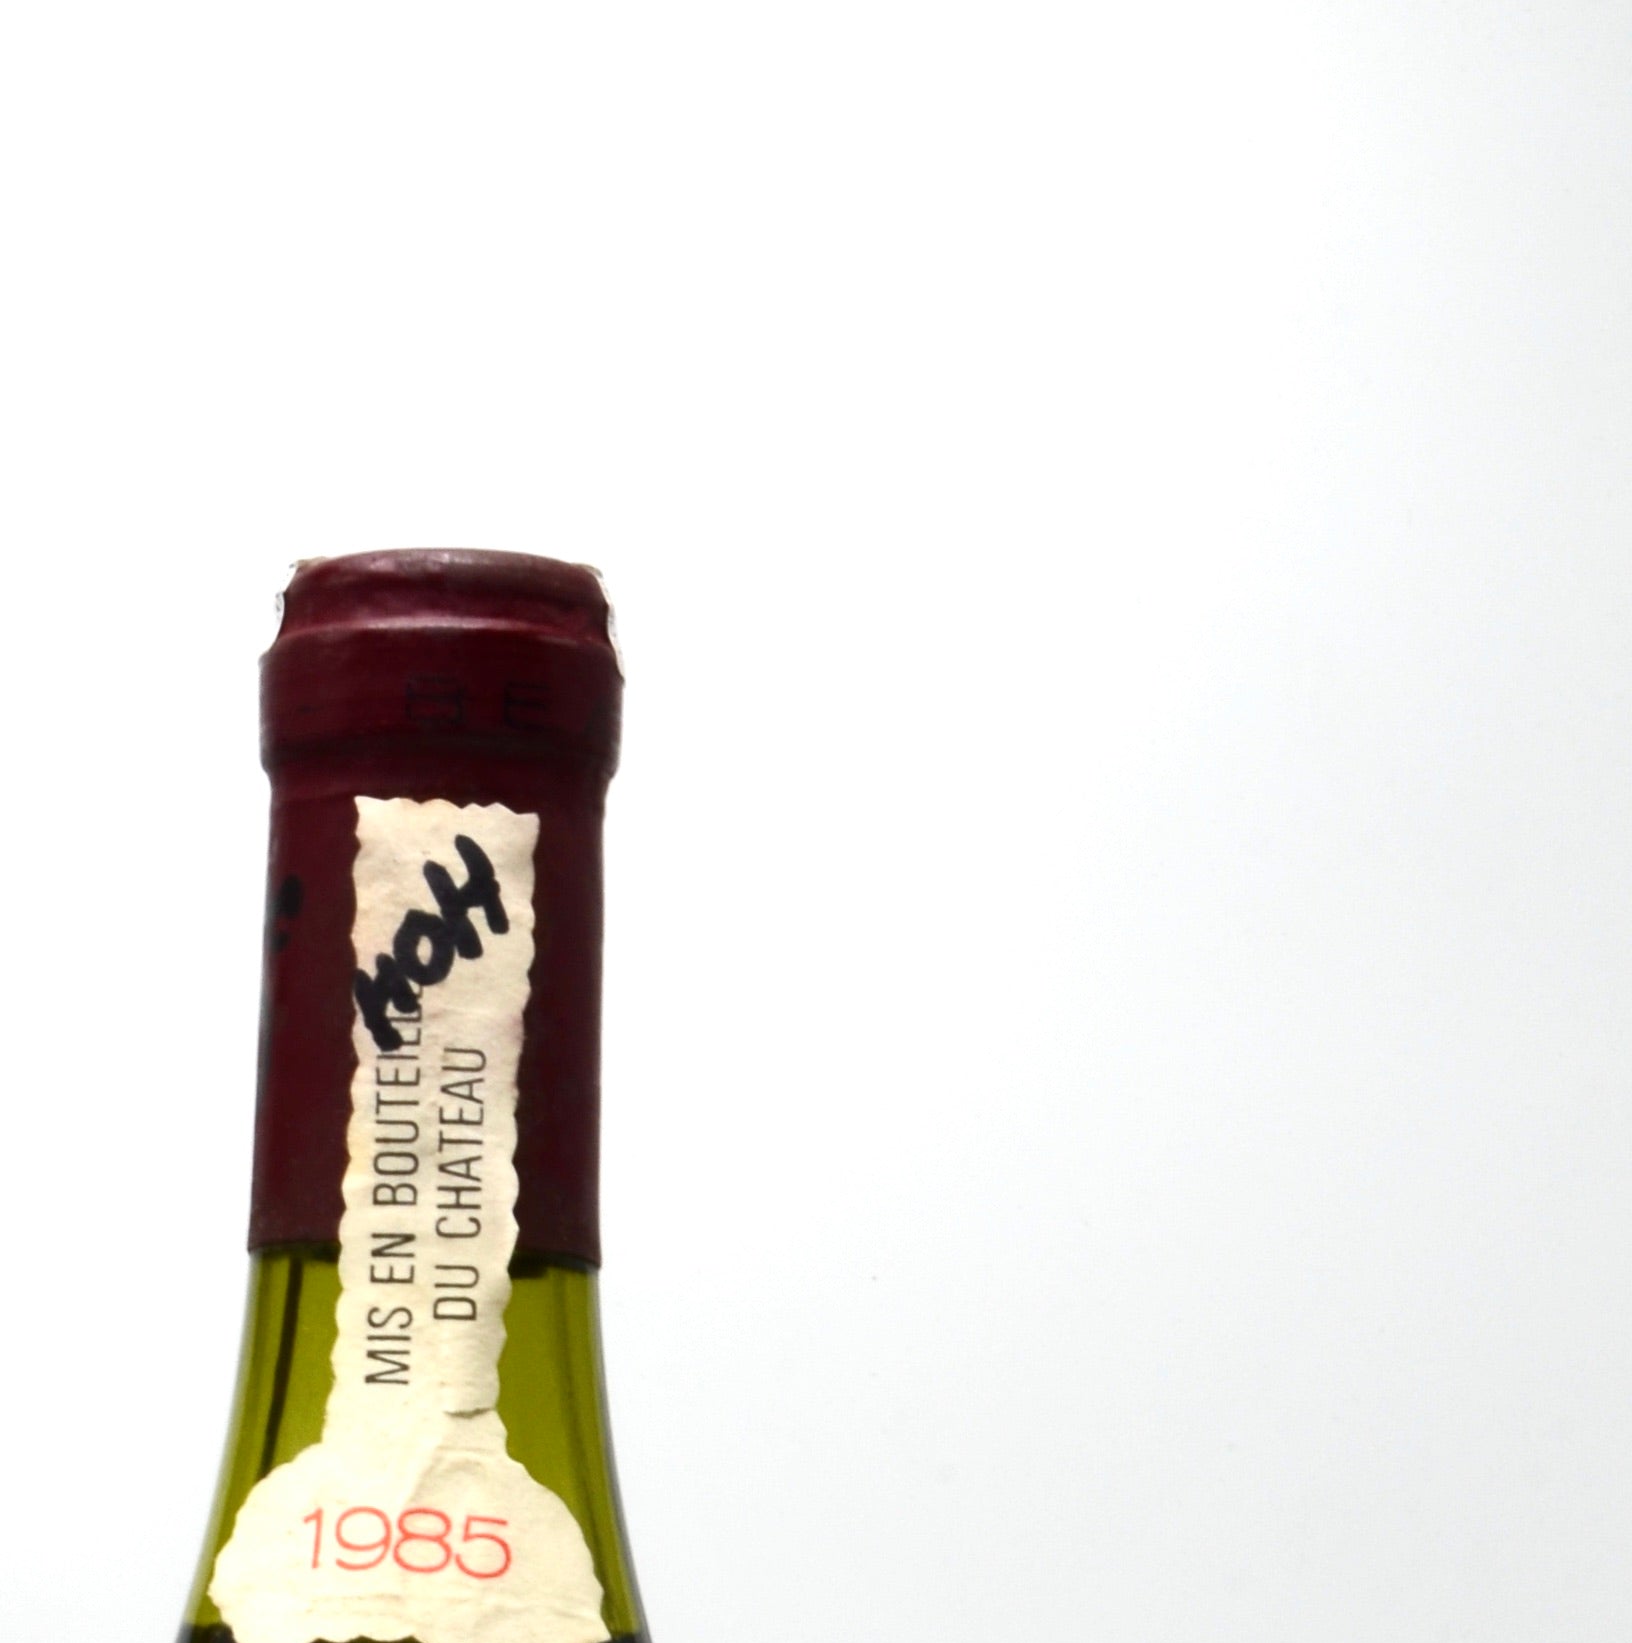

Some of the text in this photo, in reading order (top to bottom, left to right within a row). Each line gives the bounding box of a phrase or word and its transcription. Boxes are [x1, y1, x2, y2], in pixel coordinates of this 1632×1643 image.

[433, 1047, 489, 1321] DU CHATEAU
[371, 1231, 416, 1285] EN
[365, 1306, 414, 1385] MIS
[303, 1506, 513, 1579] 1985
